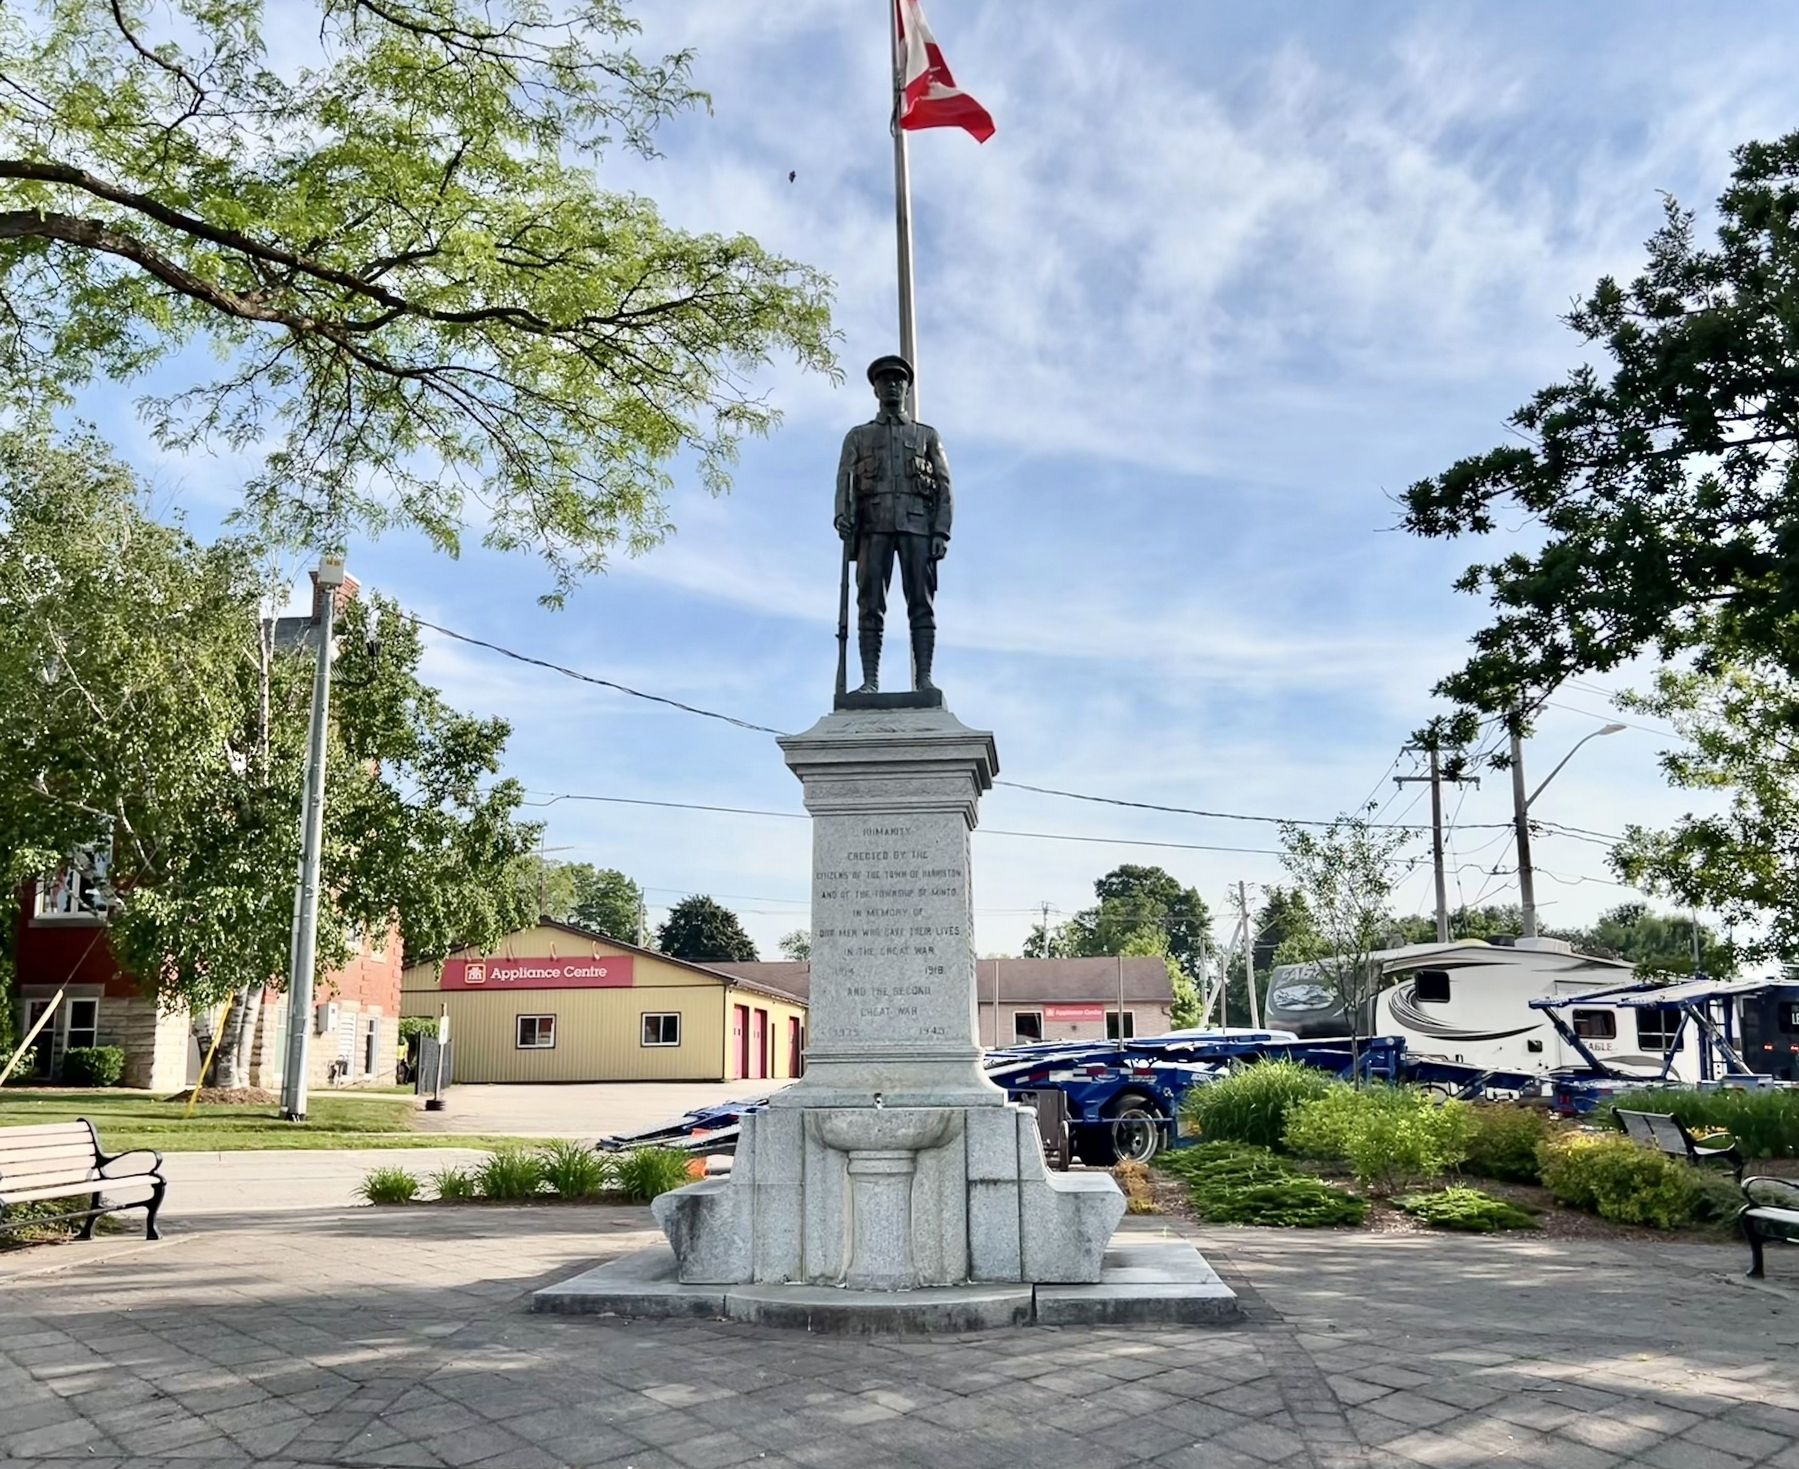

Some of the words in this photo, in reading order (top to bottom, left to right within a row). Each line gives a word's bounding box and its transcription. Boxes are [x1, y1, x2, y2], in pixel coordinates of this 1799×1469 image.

[847, 851, 889, 861] ERECTED
[893, 851, 906, 860] BY
[912, 850, 928, 859] THE
[816, 872, 849, 880] CITIZENS
[866, 871, 880, 879] THE
[910, 870, 919, 878] OF
[821, 891, 838, 899] AND
[932, 888, 957, 896] MINTO
[867, 908, 908, 916] MEMORY
[912, 908, 923, 916] OF
[838, 929, 857, 937] MEN
[910, 927, 932, 936] THEIR
[936, 926, 960, 936] LIVES
[844, 948, 853, 956] IN
[858, 947, 874, 956] THE
[880, 946, 909, 956] GREAT
[914, 946, 935, 955] WAR
[490, 967, 560, 981] Appliance
[563, 966, 608, 978] Centre
[924, 965, 944, 974] 1918
[847, 987, 866, 996] AND
[871, 987, 888, 996] THE
[892, 986, 931, 996] SECOND
[860, 1007, 890, 1016] GREAT
[898, 1007, 918, 1016] WAR
